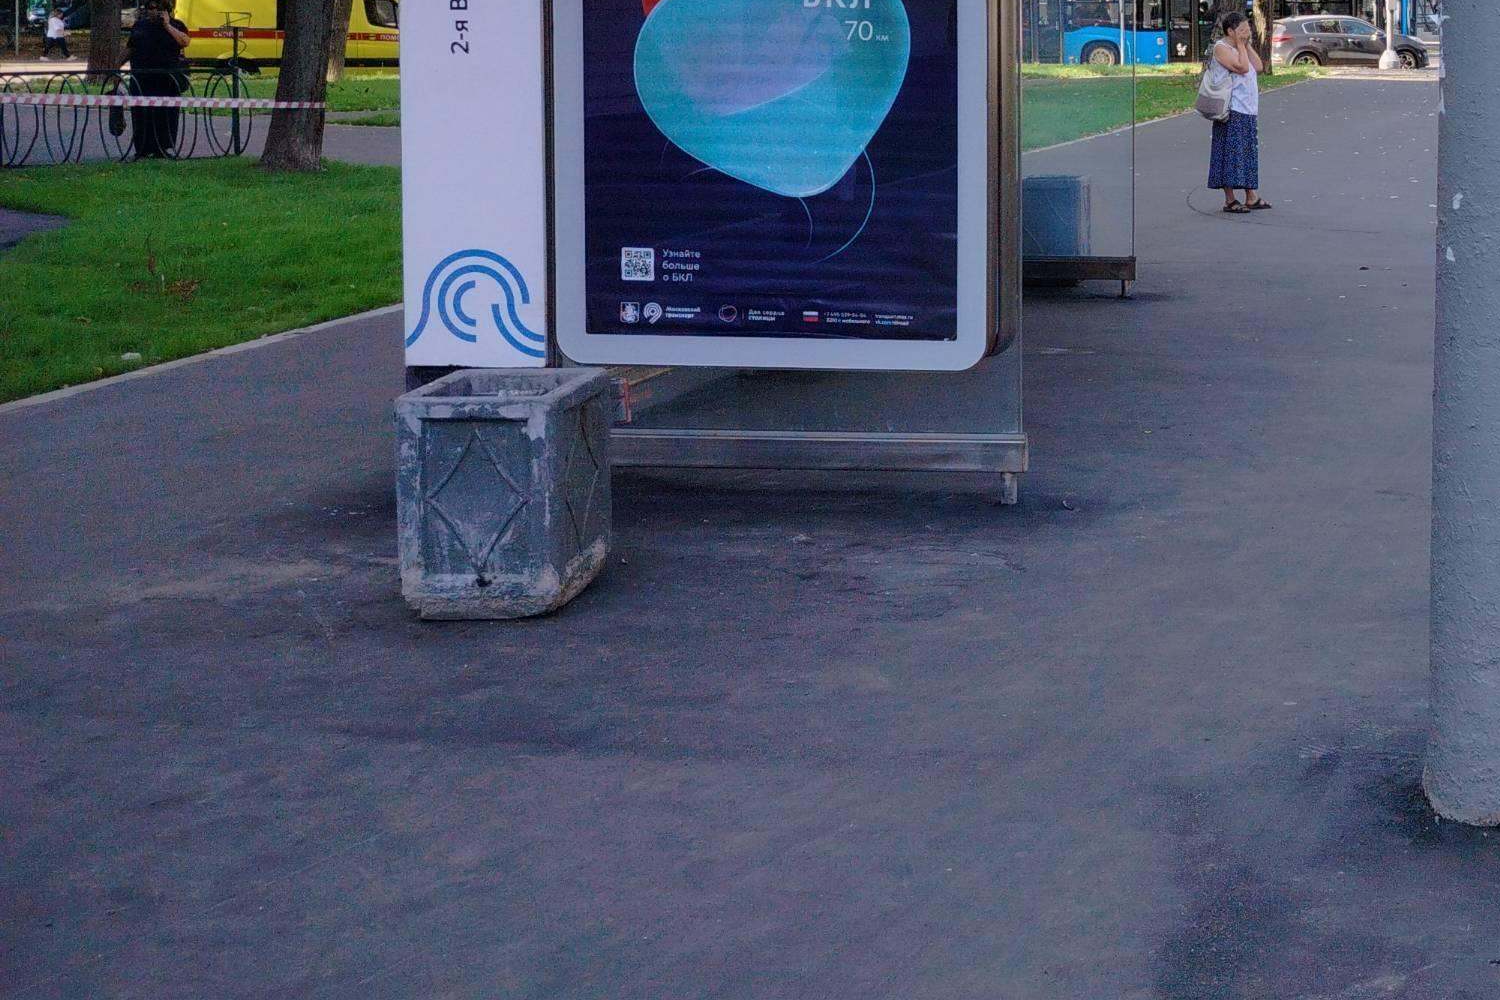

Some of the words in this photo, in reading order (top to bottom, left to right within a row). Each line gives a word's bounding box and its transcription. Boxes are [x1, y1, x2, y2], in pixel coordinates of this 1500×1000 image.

[450, 19, 469, 54] 2-я
[844, 20, 874, 42] 70
[662, 248, 700, 260] Узнайте
[662, 260, 700, 271] больше
[672, 271, 693, 282] БКЛ
